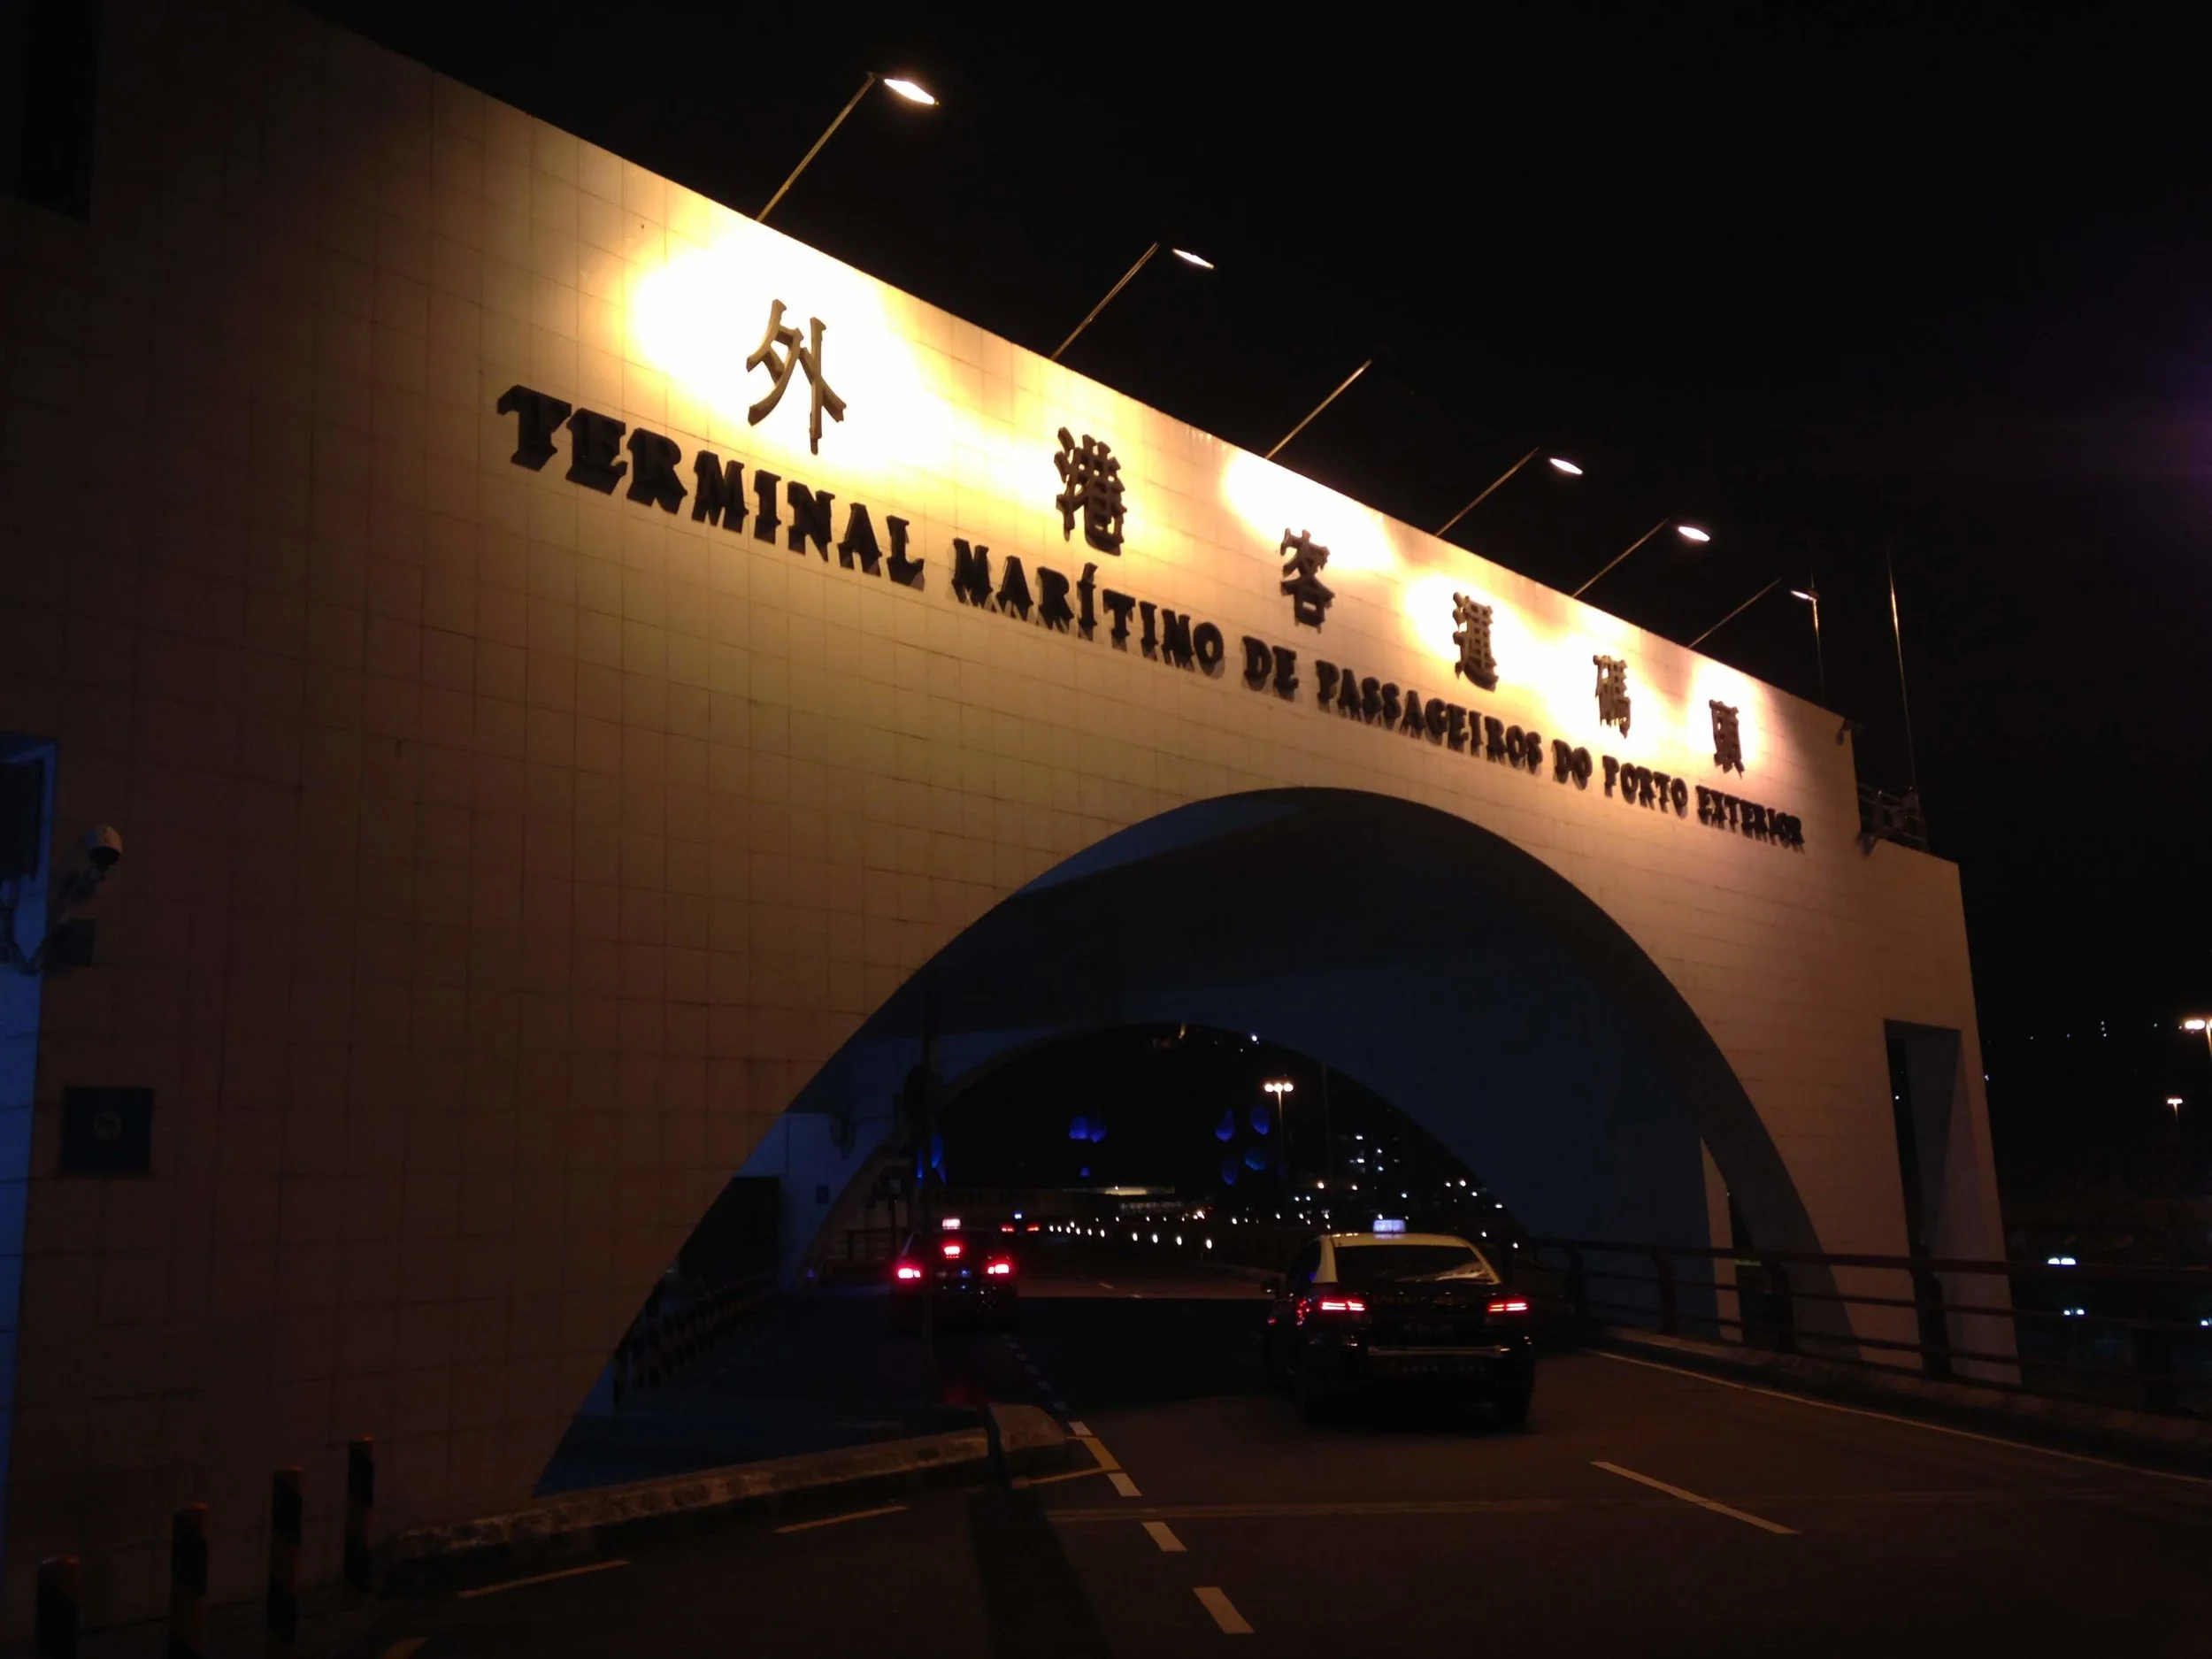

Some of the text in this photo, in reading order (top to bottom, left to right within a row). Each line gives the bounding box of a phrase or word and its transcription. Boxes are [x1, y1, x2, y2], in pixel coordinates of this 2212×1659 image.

[496, 385, 1805, 848] TERMINAL MARÍTIMO DE PASSAGEIROS DO PORTO EXTERIOR
